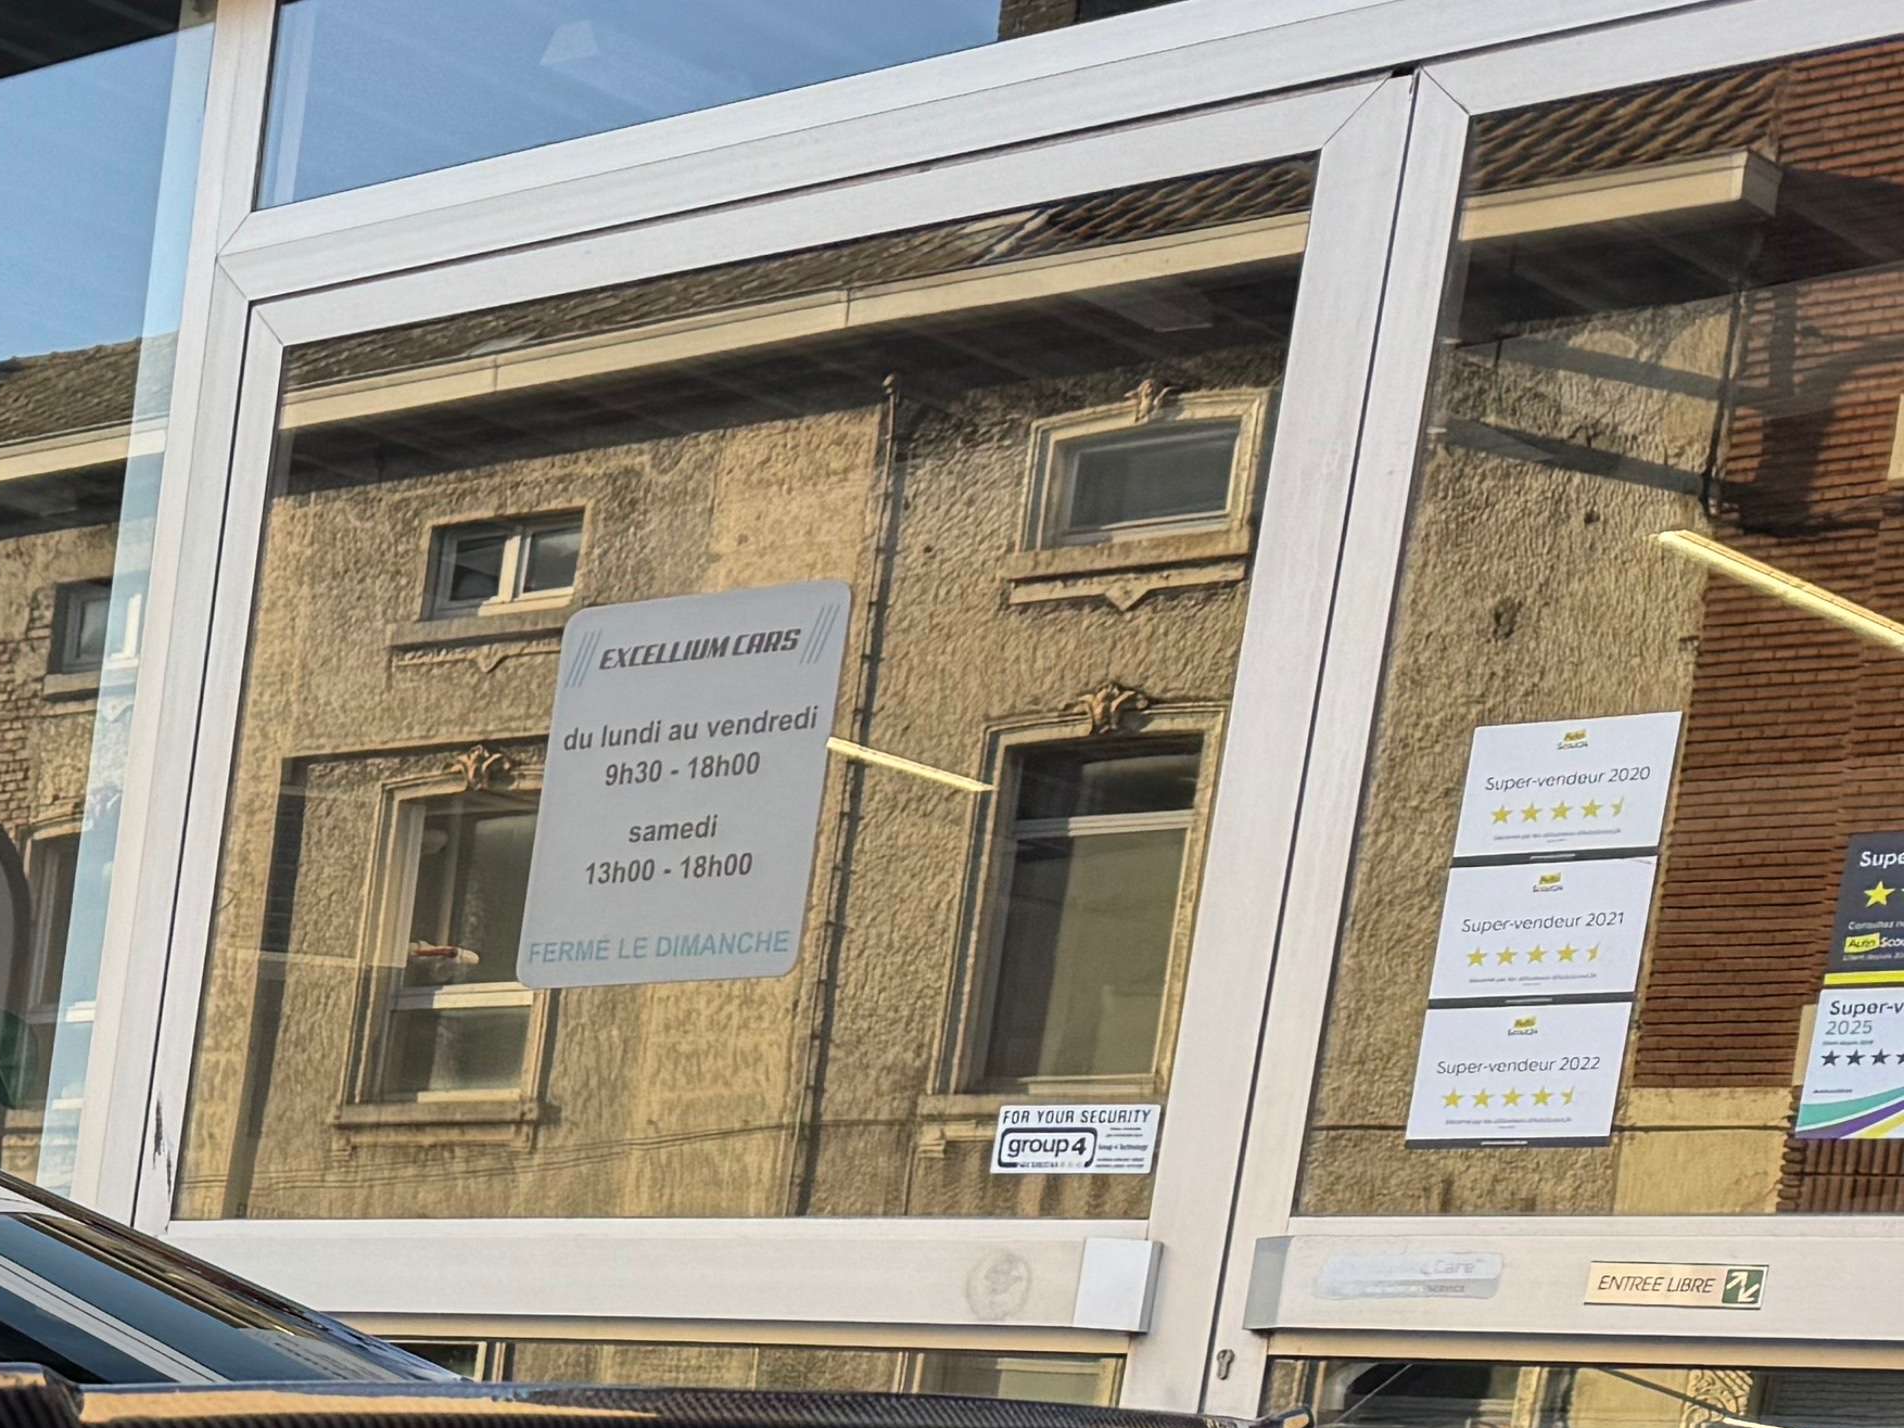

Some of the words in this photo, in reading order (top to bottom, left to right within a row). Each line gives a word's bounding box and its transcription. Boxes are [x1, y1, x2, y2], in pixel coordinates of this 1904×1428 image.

[599, 636, 731, 671] EXCELLIUM
[732, 628, 801, 656] CARS
[563, 728, 592, 751] du
[600, 721, 662, 748] lundi
[668, 723, 698, 742] au
[707, 706, 819, 738] vendredi
[605, 760, 662, 787] 9h30
[687, 752, 760, 779] 18h00
[1485, 771, 1605, 792] Super-vendeur
[1608, 766, 1651, 783] 2020
[628, 814, 718, 843] samedi
[585, 859, 655, 885] 13h00
[679, 853, 753, 879] 18h00
[1461, 915, 1583, 935] Super-vendeur
[1585, 912, 1625, 927] 2021
[619, 938, 648, 959] LE
[655, 931, 790, 958] DIMANCHE
[1825, 1020, 1872, 1035] 2025
[1436, 1059, 1556, 1076] Super-vendeur
[1559, 1056, 1601, 1071] 2022
[1003, 1110, 1030, 1124] FOR
[1038, 1110, 1074, 1124] YOUR
[1080, 1109, 1151, 1124] SECURITY
[1598, 1275, 1664, 1292] ENTREE
[1667, 1277, 1715, 1293] LIBRE
